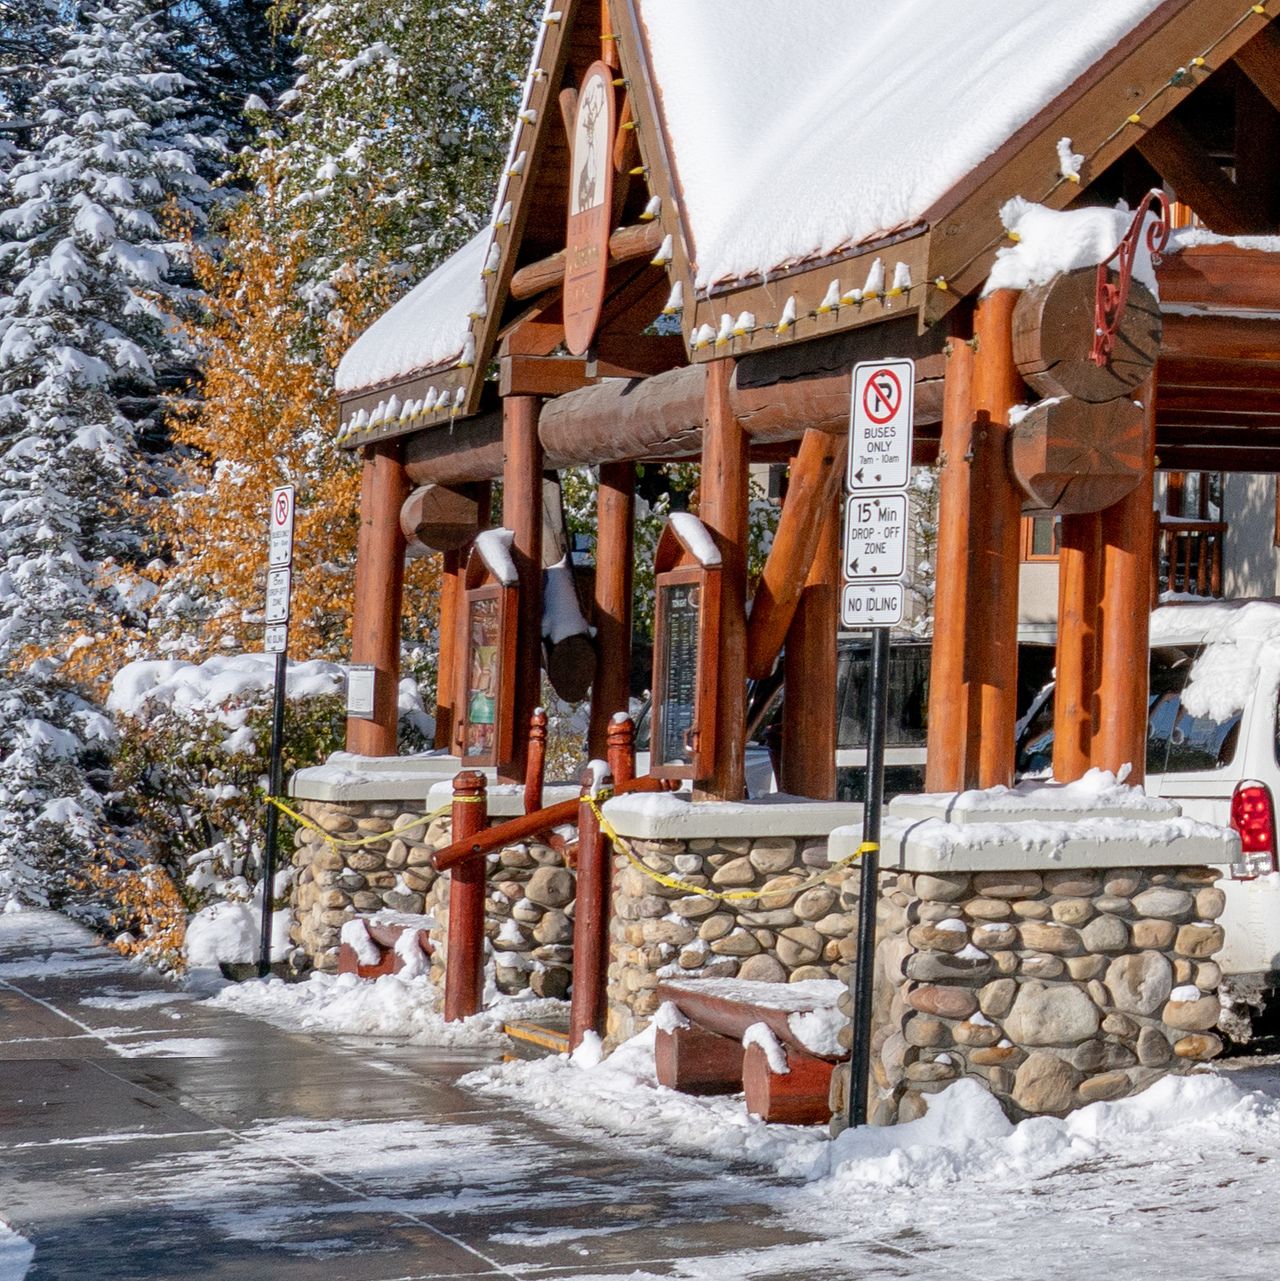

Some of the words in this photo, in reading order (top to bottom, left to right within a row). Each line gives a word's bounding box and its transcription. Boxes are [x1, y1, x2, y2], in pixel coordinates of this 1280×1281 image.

[864, 426, 896, 439] BUSES
[867, 441, 892, 453] ONLY
[860, 455, 874, 464] 7am
[881, 454, 899, 463] 10am
[858, 503, 871, 522] 15
[878, 507, 897, 521] Min
[852, 527, 874, 539] DROP
[884, 526, 900, 538] OFF
[864, 542, 887, 554] ZONE
[848, 598, 862, 611] NO
[866, 596, 897, 611] IDLING
